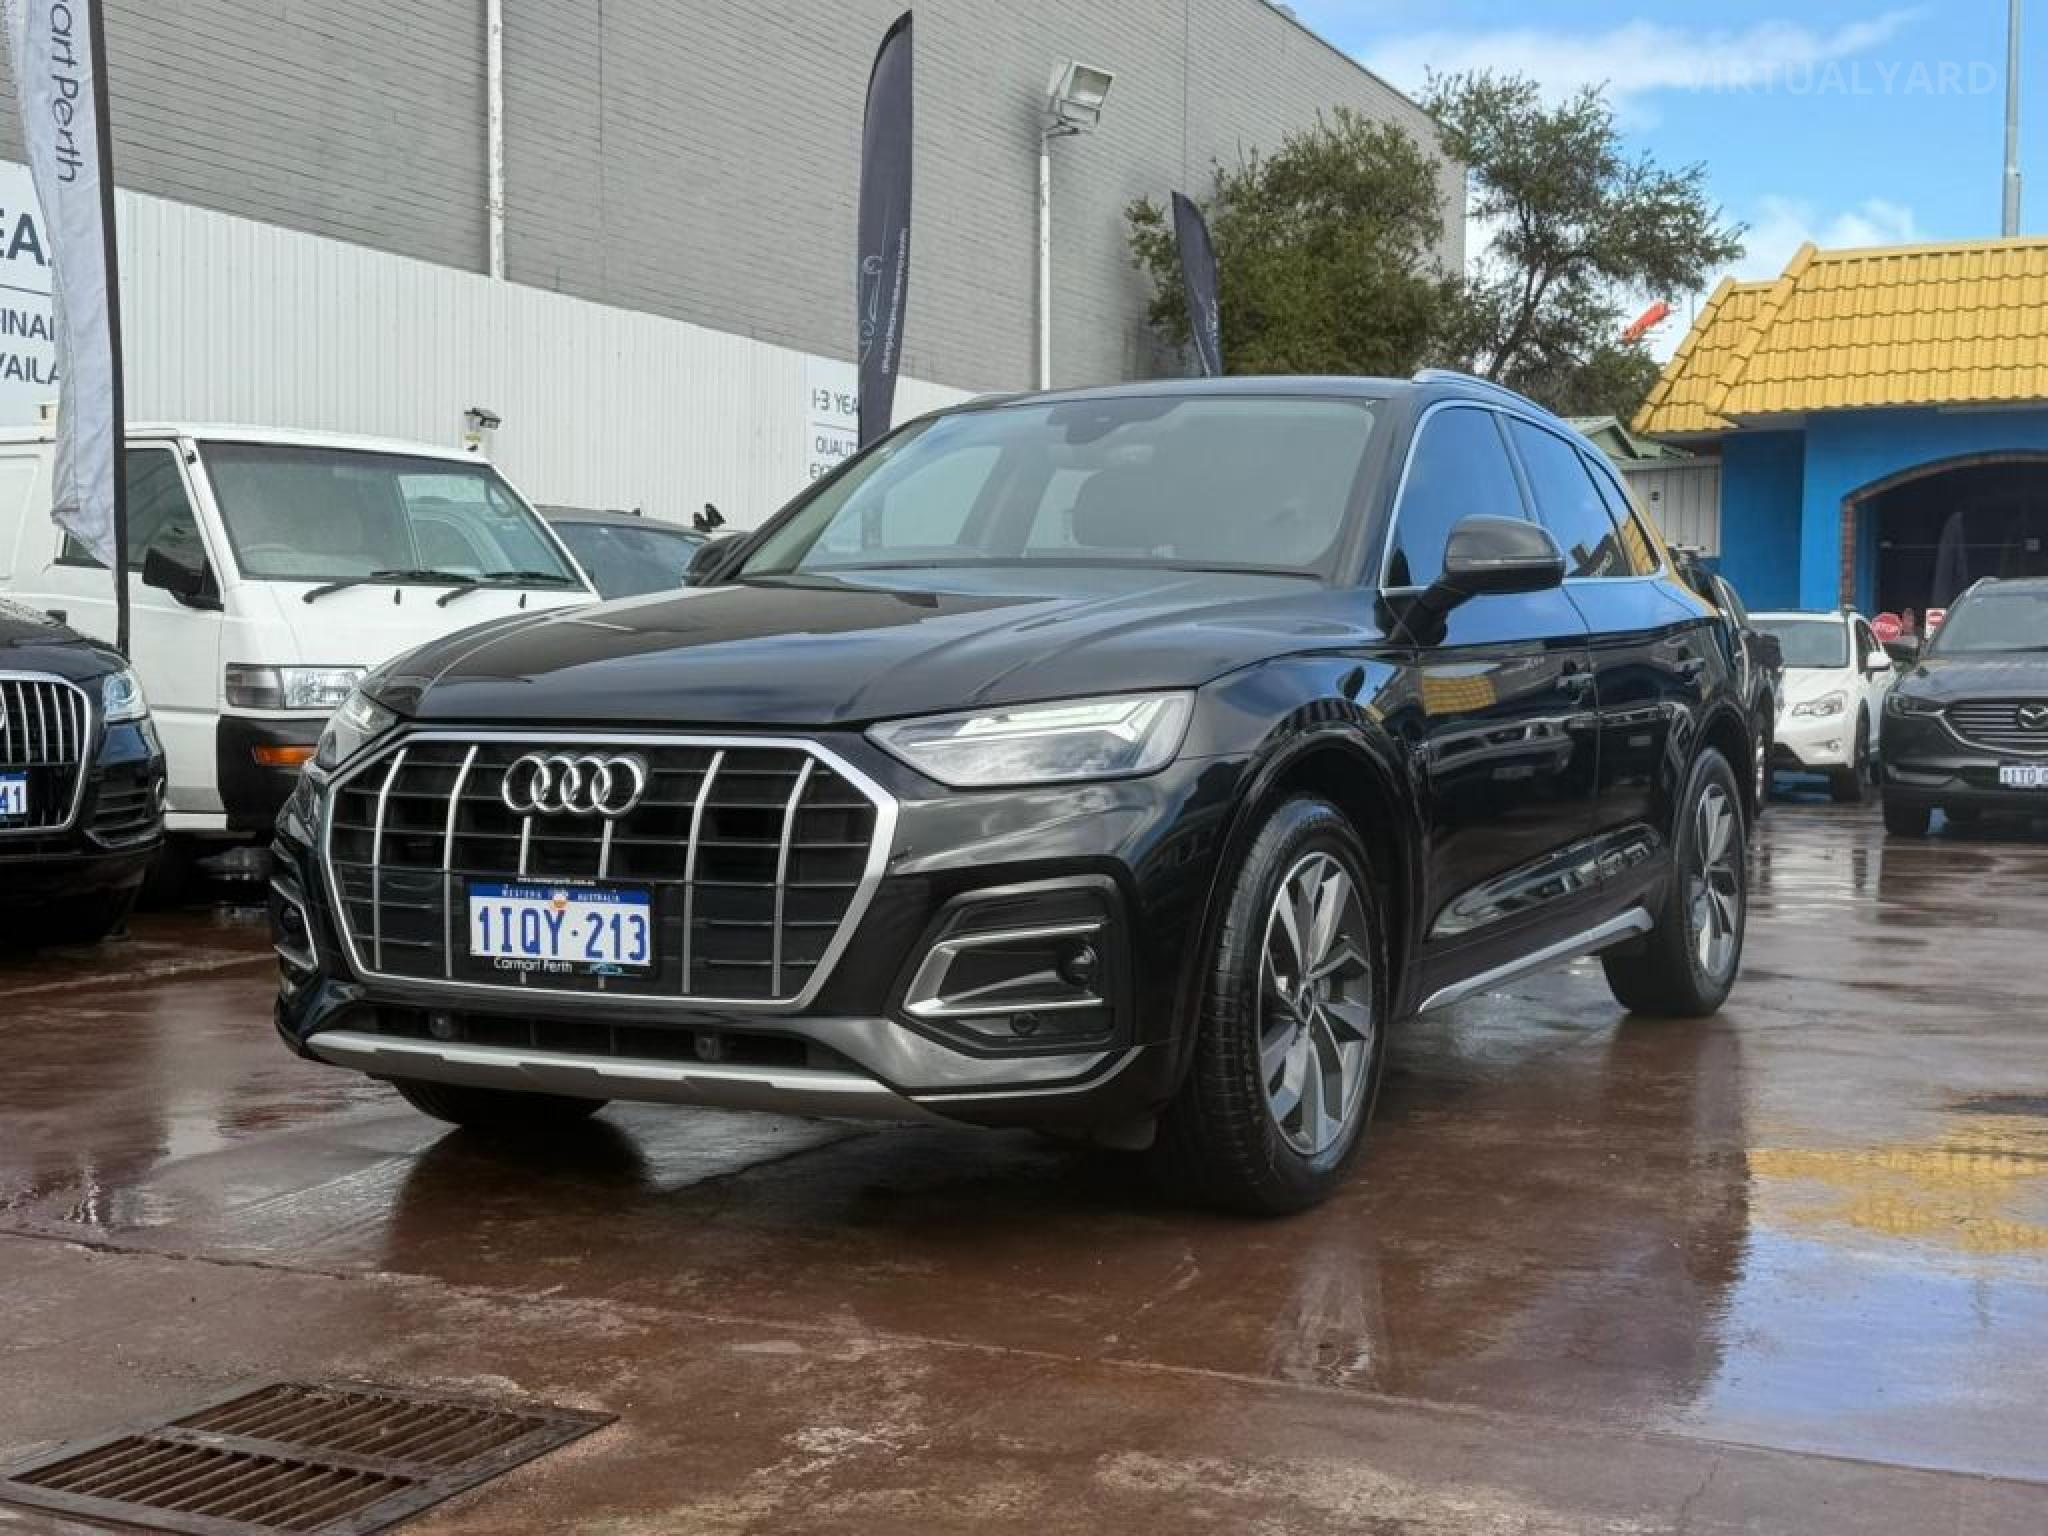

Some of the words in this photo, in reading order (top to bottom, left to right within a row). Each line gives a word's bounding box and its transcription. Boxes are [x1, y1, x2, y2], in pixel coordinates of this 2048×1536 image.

[51, 0, 79, 68] art
[51, 74, 84, 182] Perth
[1874, 621, 1899, 633] STOP
[577, 892, 621, 902] AUSTRALIA
